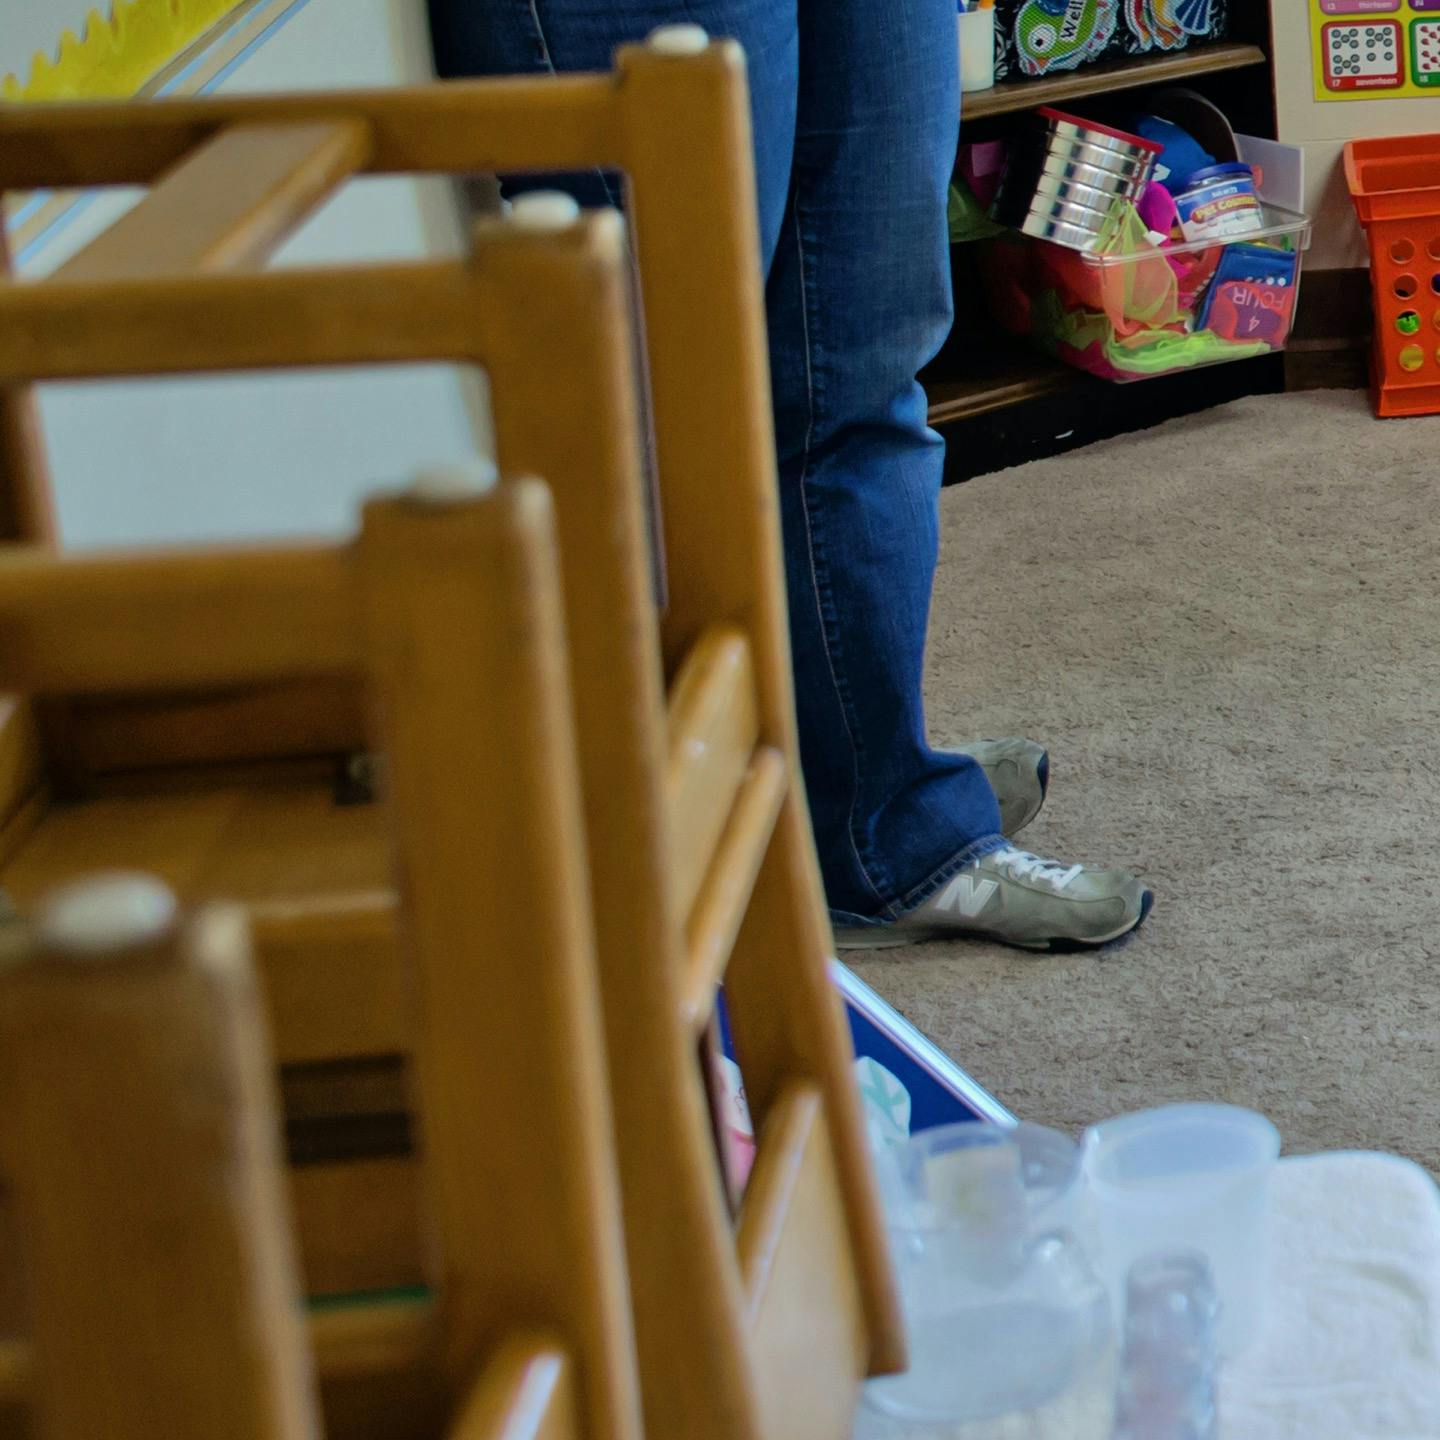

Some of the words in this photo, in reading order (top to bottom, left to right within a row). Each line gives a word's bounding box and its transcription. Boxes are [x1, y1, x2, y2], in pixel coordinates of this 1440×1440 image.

[1332, 79, 1341, 88] 17
[1355, 76, 1398, 87] seventeen
[1232, 286, 1287, 310] FOUR
[1249, 315, 1260, 332] 4
